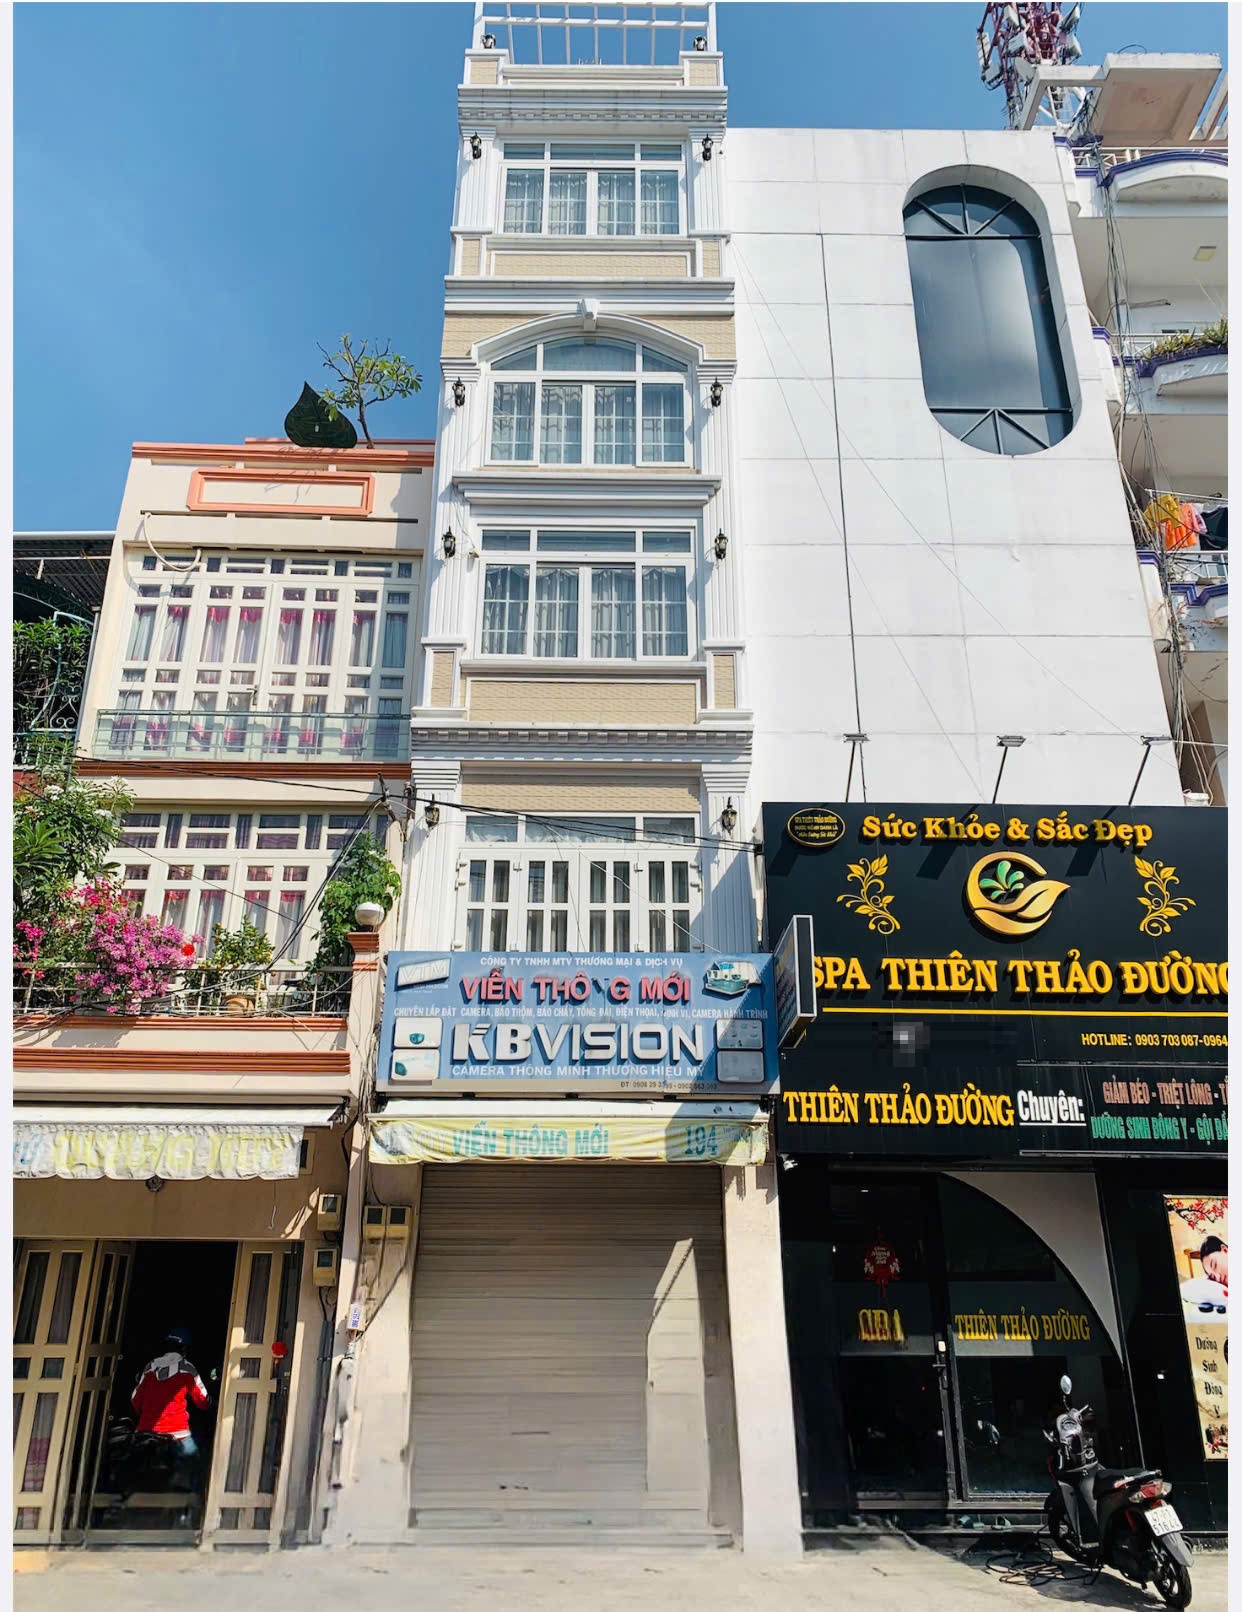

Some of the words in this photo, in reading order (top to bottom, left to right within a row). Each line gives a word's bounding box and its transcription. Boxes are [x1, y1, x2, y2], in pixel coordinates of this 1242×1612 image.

[862, 813, 917, 838] Sức
[923, 814, 1000, 839] Khỏe
[1007, 817, 1030, 840] &
[1037, 811, 1088, 840] Sắc
[1094, 819, 1152, 847] Đẹp
[480, 956, 507, 966] CÔNG
[510, 957, 522, 966] TY
[524, 957, 550, 966] TNHH
[552, 957, 573, 966] MTV
[616, 957, 633, 969] MẠI
[635, 958, 642, 966] &
[670, 958, 683, 969] VỤ
[813, 956, 871, 990] SPA
[881, 950, 998, 992] THIÊN
[1007, 948, 1113, 994] THẢO
[462, 967, 523, 1001] VIỄN
[641, 970, 691, 1001] MỚI
[537, 1006, 551, 1017] BÁO
[691, 1009, 721, 1018] CAMERA
[452, 1023, 704, 1061] KBVISION
[1081, 1033, 1132, 1046] HOTLINE:
[1135, 1034, 1160, 1046] 0903
[1162, 1035, 1180, 1047] 703
[452, 1066, 505, 1076] CAMERA
[510, 1064, 552, 1076] THÔNG
[557, 1066, 591, 1076] MINH
[651, 1065, 682, 1078] HIỆU
[783, 1084, 859, 1124] THIÊN
[864, 1083, 931, 1124] THẢO
[936, 1083, 1014, 1126] ĐƯỜNG
[1017, 1090, 1085, 1123] Chuyên:
[1102, 1074, 1129, 1104] GIẢM
[1129, 1077, 1150, 1104] BÉO
[1157, 1078, 1185, 1109] TRIỆT
[1186, 1078, 1213, 1105] LÔNG
[503, 1123, 569, 1155] THÔNG
[575, 1123, 609, 1154] MỚI
[684, 1125, 718, 1155] 194
[1091, 1111, 1126, 1139] DƯỠNG
[1127, 1117, 1151, 1139] SINH
[1180, 1117, 1188, 1139] Y
[1196, 1113, 1215, 1145] GỘI
[955, 1308, 998, 1340] THIÊN
[1001, 1306, 1040, 1340] THẢO
[1041, 1308, 1090, 1340] ĐƯỜNG
